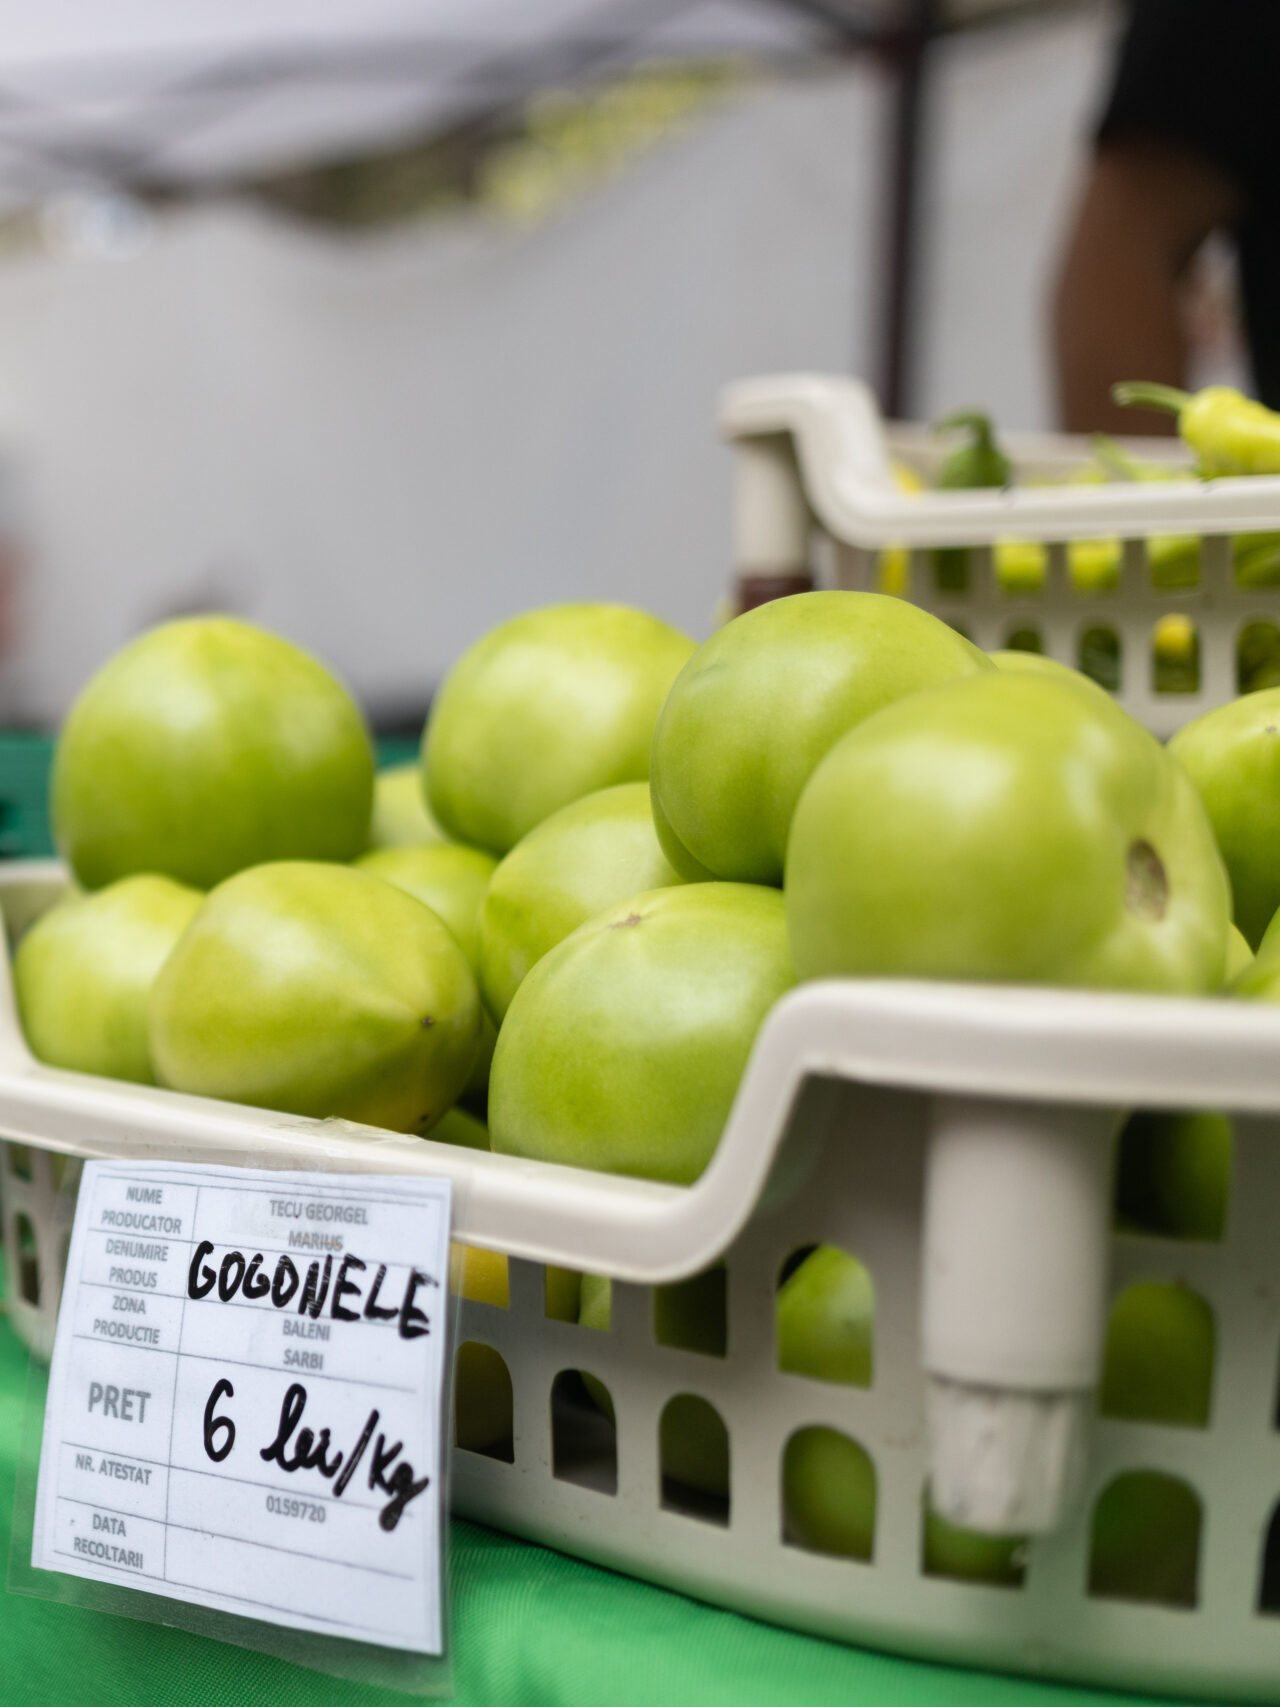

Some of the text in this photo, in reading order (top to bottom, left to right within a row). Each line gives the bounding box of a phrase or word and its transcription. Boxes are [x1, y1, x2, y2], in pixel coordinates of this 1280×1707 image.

[126, 1186, 162, 1205] NUME
[101, 1210, 181, 1234] PRODUCATOR
[269, 1200, 368, 1225] TECU GEORGEL
[105, 1239, 168, 1262] DENUMIRE
[288, 1230, 343, 1250] MARIUS
[109, 1266, 157, 1288] PRODUS
[188, 1241, 439, 1339] GOGONELE
[112, 1295, 146, 1315] ZONA
[93, 1318, 160, 1345] PRODUCTIE
[283, 1320, 330, 1342] BALENI
[283, 1349, 323, 1370] SARBI
[88, 1382, 151, 1423] PRET
[203, 1378, 235, 1462] 6
[75, 1453, 152, 1485] NR. ATESTAT
[266, 1495, 326, 1523] 0159720
[92, 1513, 126, 1537] DATA
[73, 1536, 143, 1569] RECOLTARII
